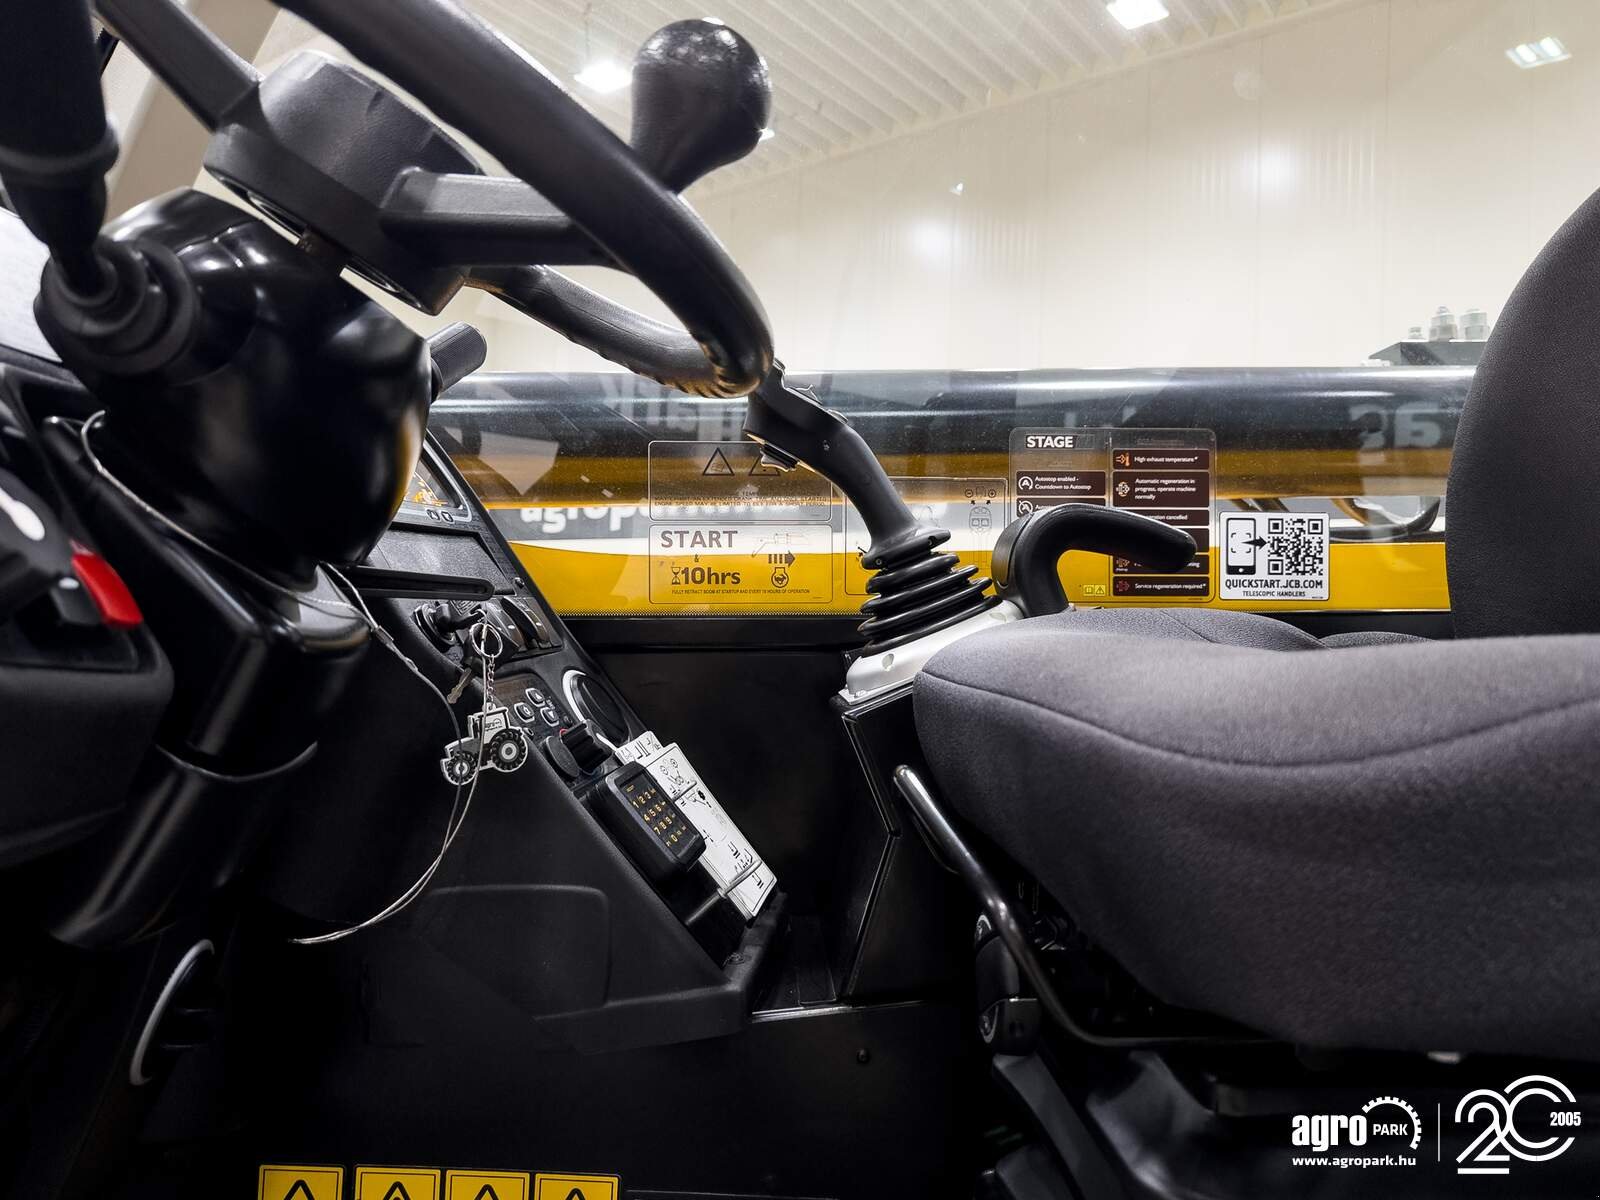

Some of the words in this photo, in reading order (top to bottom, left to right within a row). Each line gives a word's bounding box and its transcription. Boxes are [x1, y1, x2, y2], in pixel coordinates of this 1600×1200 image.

[1026, 435, 1074, 449] STAGE
[660, 530, 738, 549] START
[1225, 579, 1323, 590] QUICKSTART.JCB.COM
